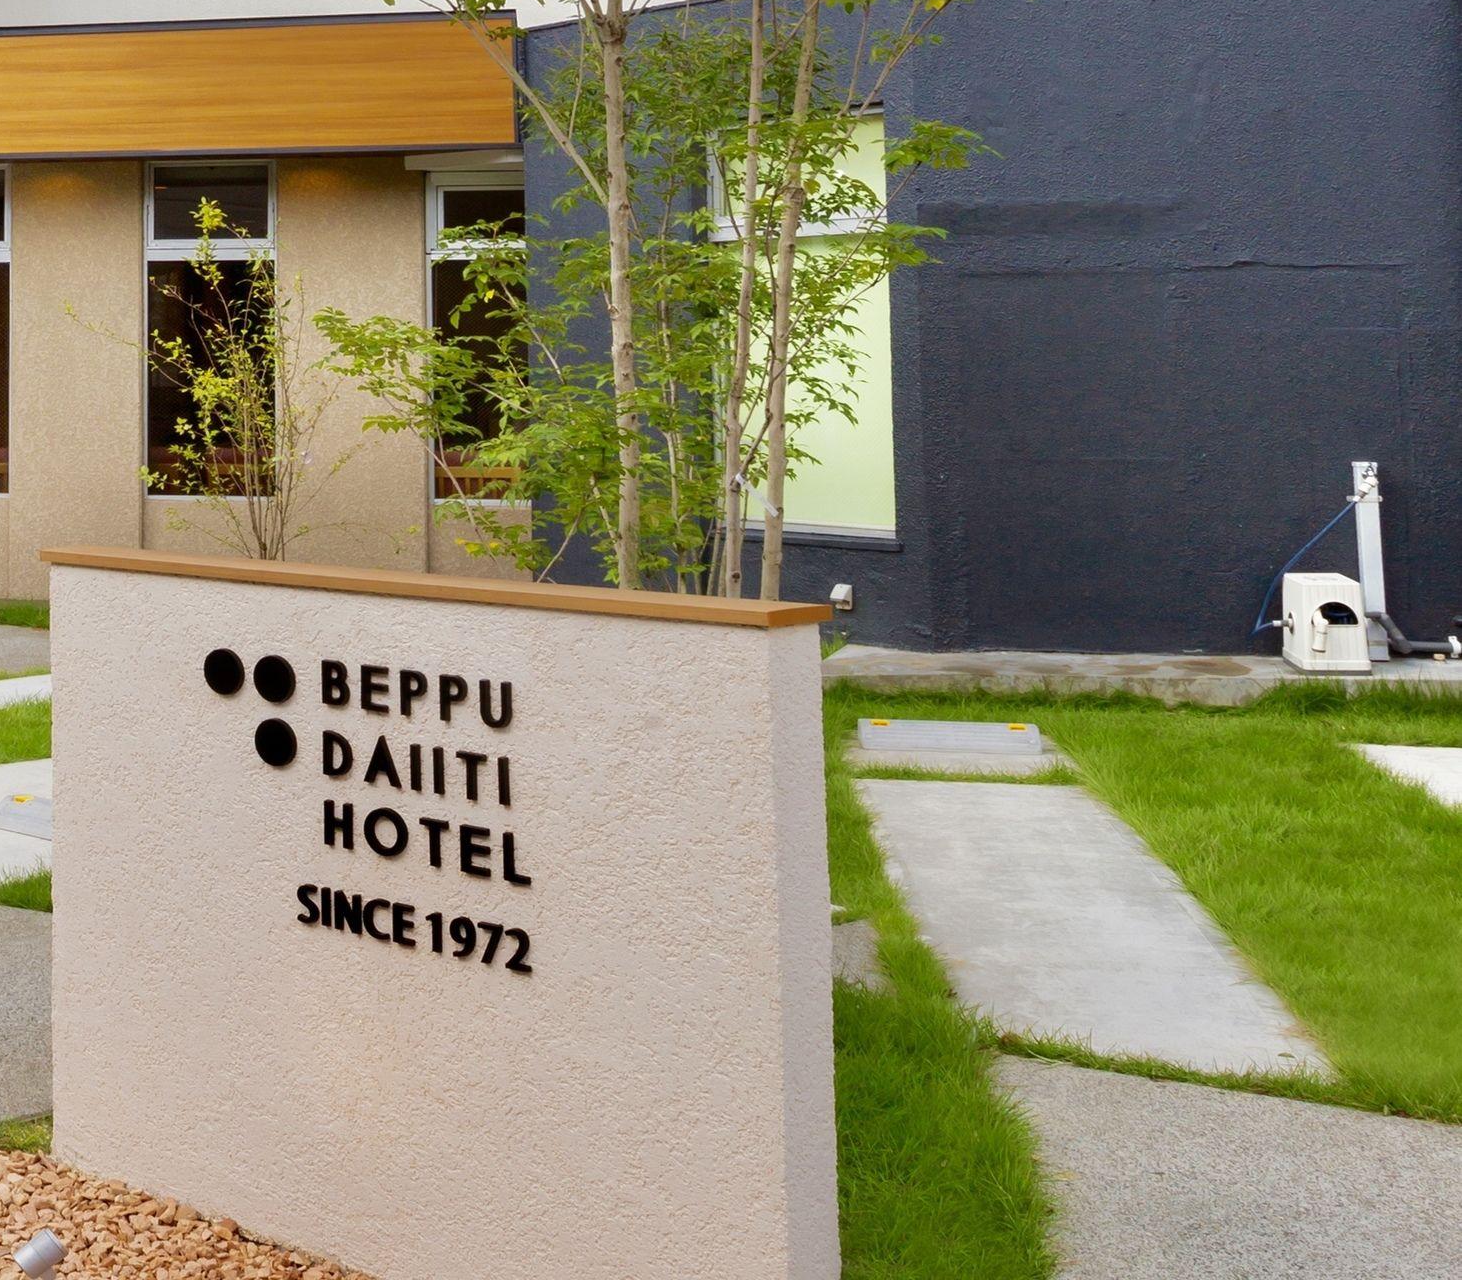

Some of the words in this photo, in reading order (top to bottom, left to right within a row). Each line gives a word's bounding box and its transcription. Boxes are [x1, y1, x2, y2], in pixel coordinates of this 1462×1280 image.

[321, 659, 513, 728] BEPPU
[322, 730, 510, 805] DAIITI
[323, 799, 532, 885] HOTEL
[296, 883, 416, 947] SINCE
[426, 912, 533, 973] 1972
